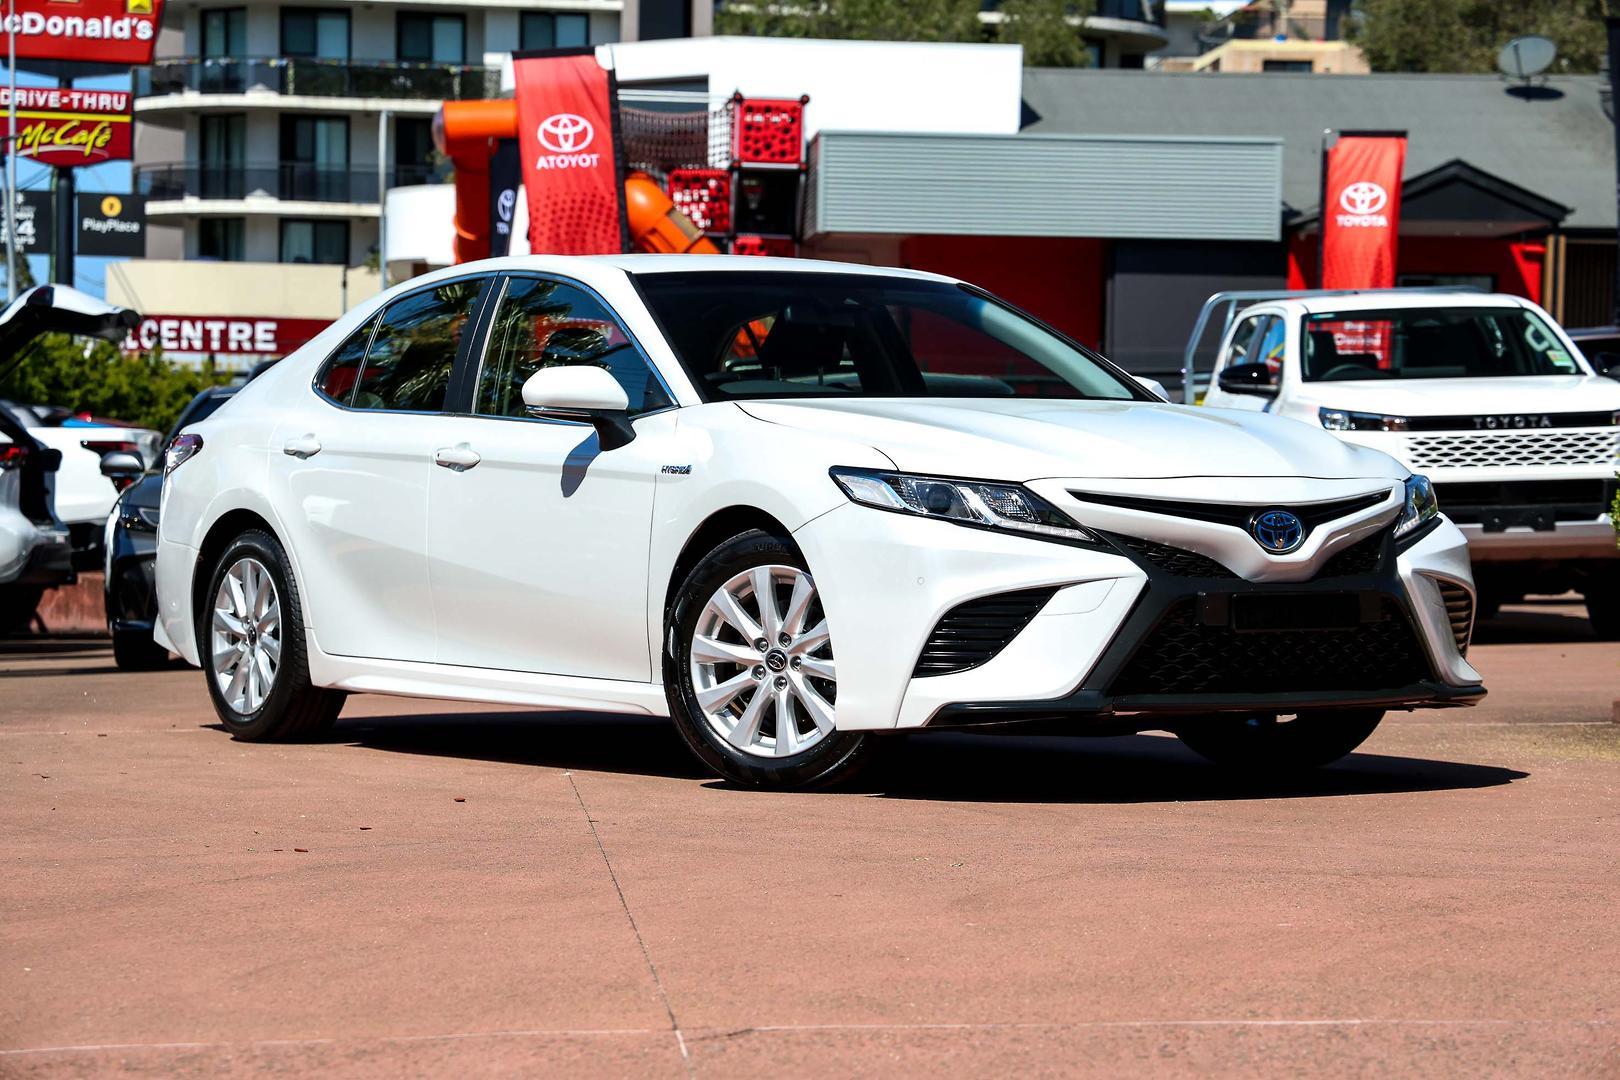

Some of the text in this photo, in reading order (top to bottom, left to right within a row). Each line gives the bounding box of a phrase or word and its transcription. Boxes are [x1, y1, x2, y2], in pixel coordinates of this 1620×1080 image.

[0, 12, 153, 40] cDonald's
[0, 88, 126, 111] DRIVE-THRU
[82, 217, 140, 234] PlayPlace
[1335, 214, 1389, 228] TOYOTA
[1473, 415, 1552, 429] TOYOTA
